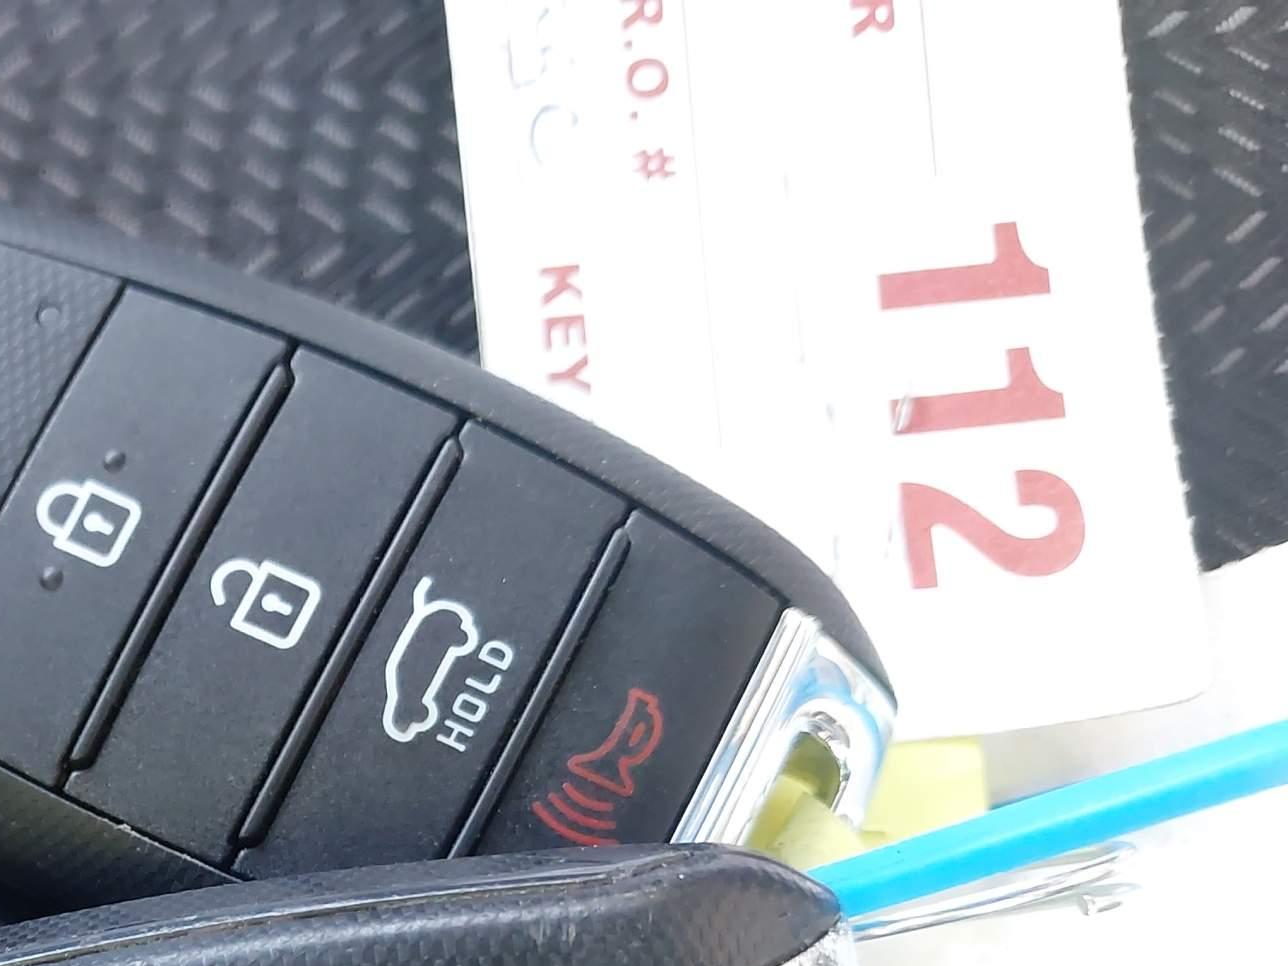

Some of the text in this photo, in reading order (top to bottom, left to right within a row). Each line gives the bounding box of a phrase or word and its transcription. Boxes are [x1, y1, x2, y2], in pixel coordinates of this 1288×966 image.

[633, 148, 676, 180] #
[540, 264, 591, 395] KEY
[877, 221, 1086, 590] 112
[436, 640, 514, 752] HOLD
